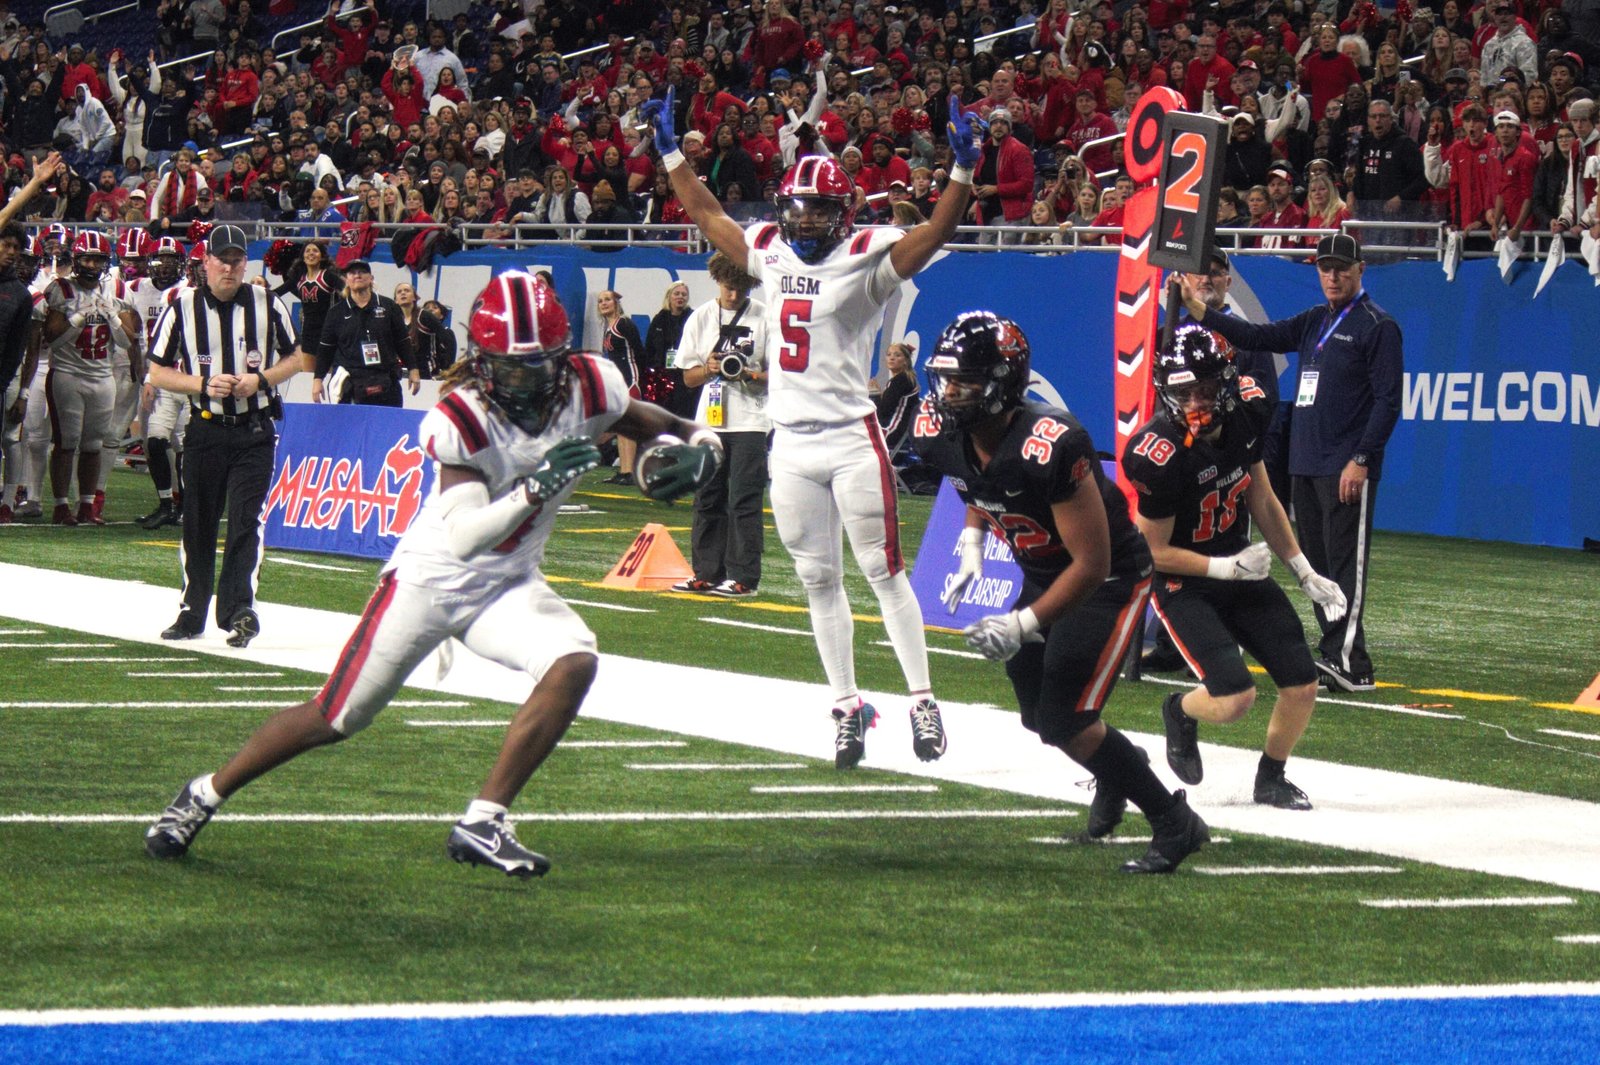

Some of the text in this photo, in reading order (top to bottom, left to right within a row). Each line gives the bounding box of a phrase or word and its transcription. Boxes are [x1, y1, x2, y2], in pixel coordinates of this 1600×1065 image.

[1163, 131, 1207, 213] 2
[301, 286, 319, 302] M
[781, 275, 821, 295] OLSM
[148, 306, 163, 317] OLS
[76, 325, 112, 360] 42
[779, 298, 813, 374] 5
[1022, 416, 1069, 466] 32
[1133, 432, 1176, 467] 18
[260, 454, 398, 537] MHSAA
[616, 532, 656, 577] 20
[940, 572, 1013, 608] SLARSHIP
